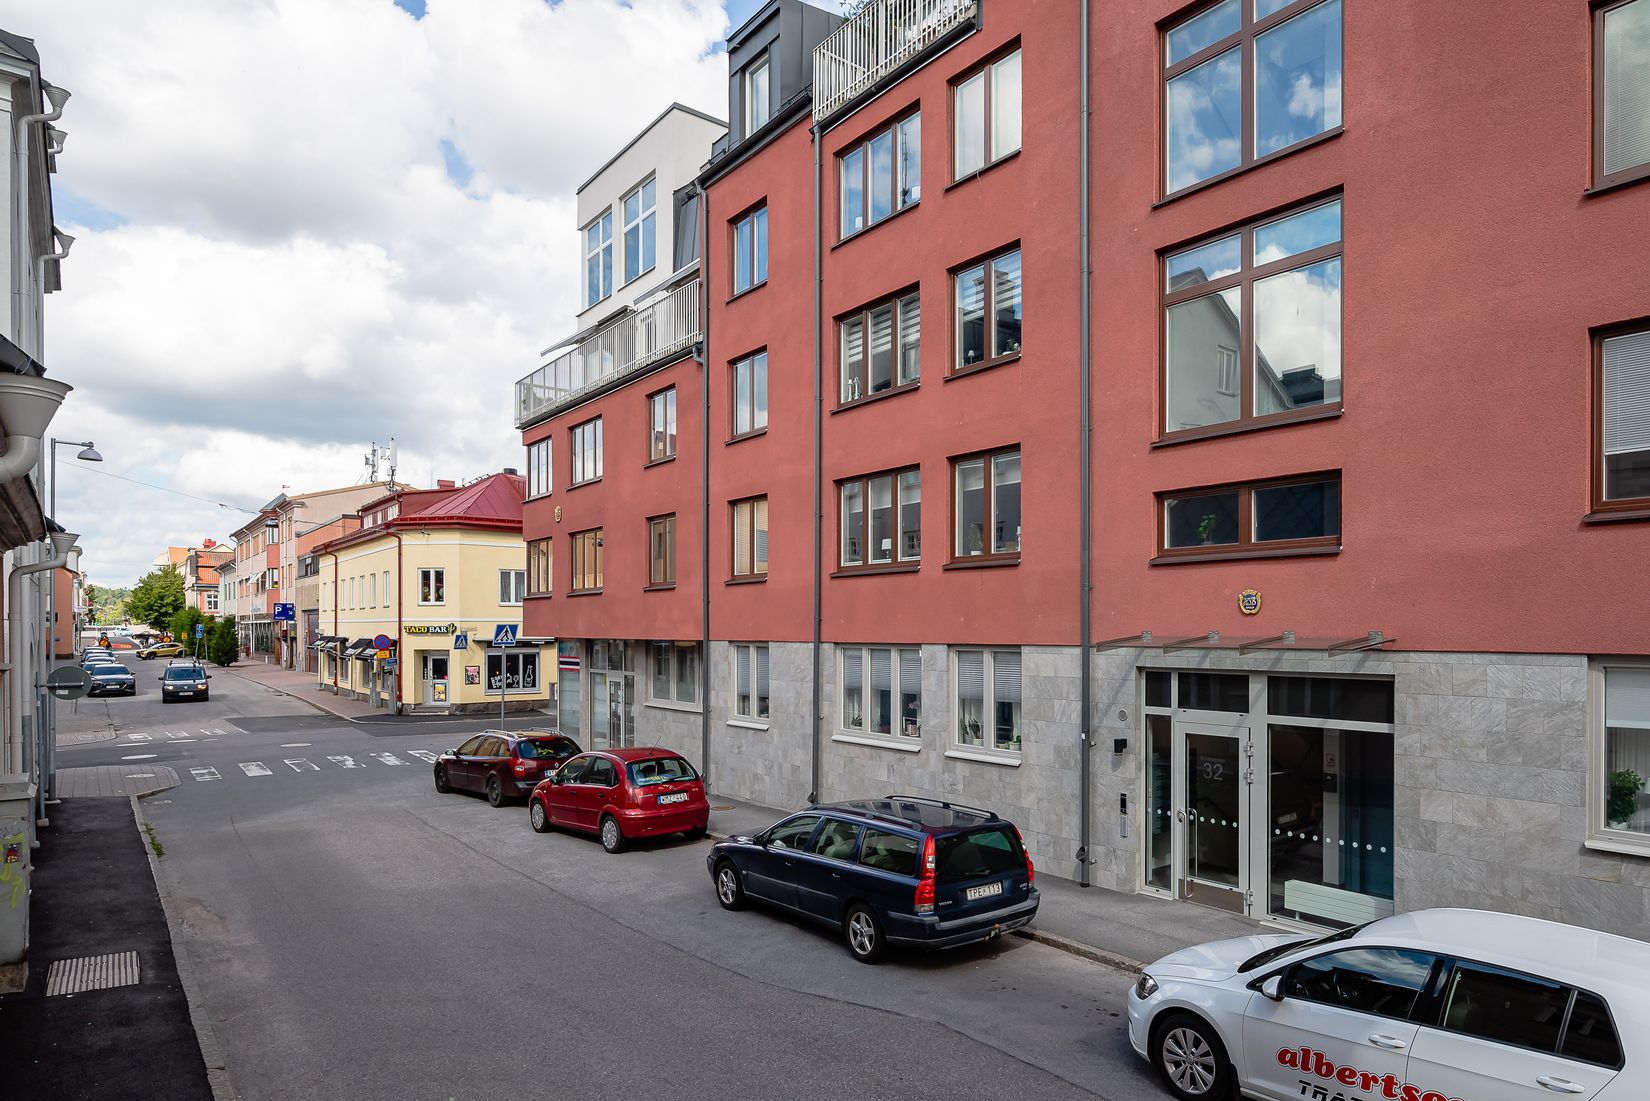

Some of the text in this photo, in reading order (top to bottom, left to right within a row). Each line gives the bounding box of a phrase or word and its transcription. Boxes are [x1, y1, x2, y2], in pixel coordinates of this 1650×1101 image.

[275, 606, 282, 615] P
[1203, 762, 1223, 780] 32
[968, 883, 1001, 899] TPE 113
[1276, 1046, 1464, 1101] alberts
